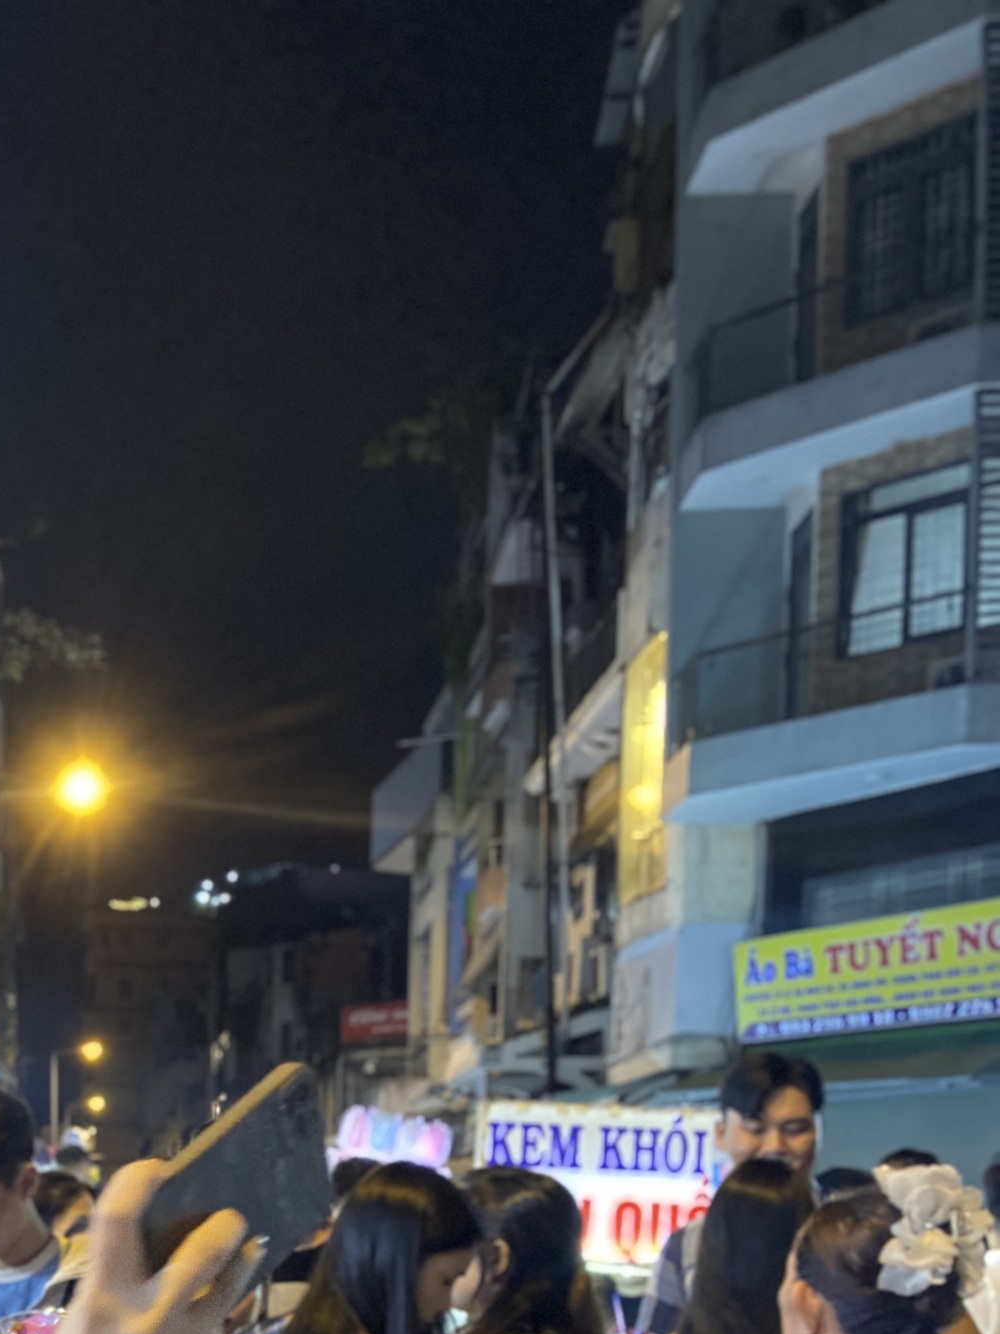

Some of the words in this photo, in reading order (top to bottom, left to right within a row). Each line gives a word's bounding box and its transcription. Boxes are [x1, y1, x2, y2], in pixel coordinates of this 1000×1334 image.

[824, 914, 943, 975] TUYẾT
[487, 1122, 582, 1168] KEM
[601, 1116, 707, 1174] KHÓI
